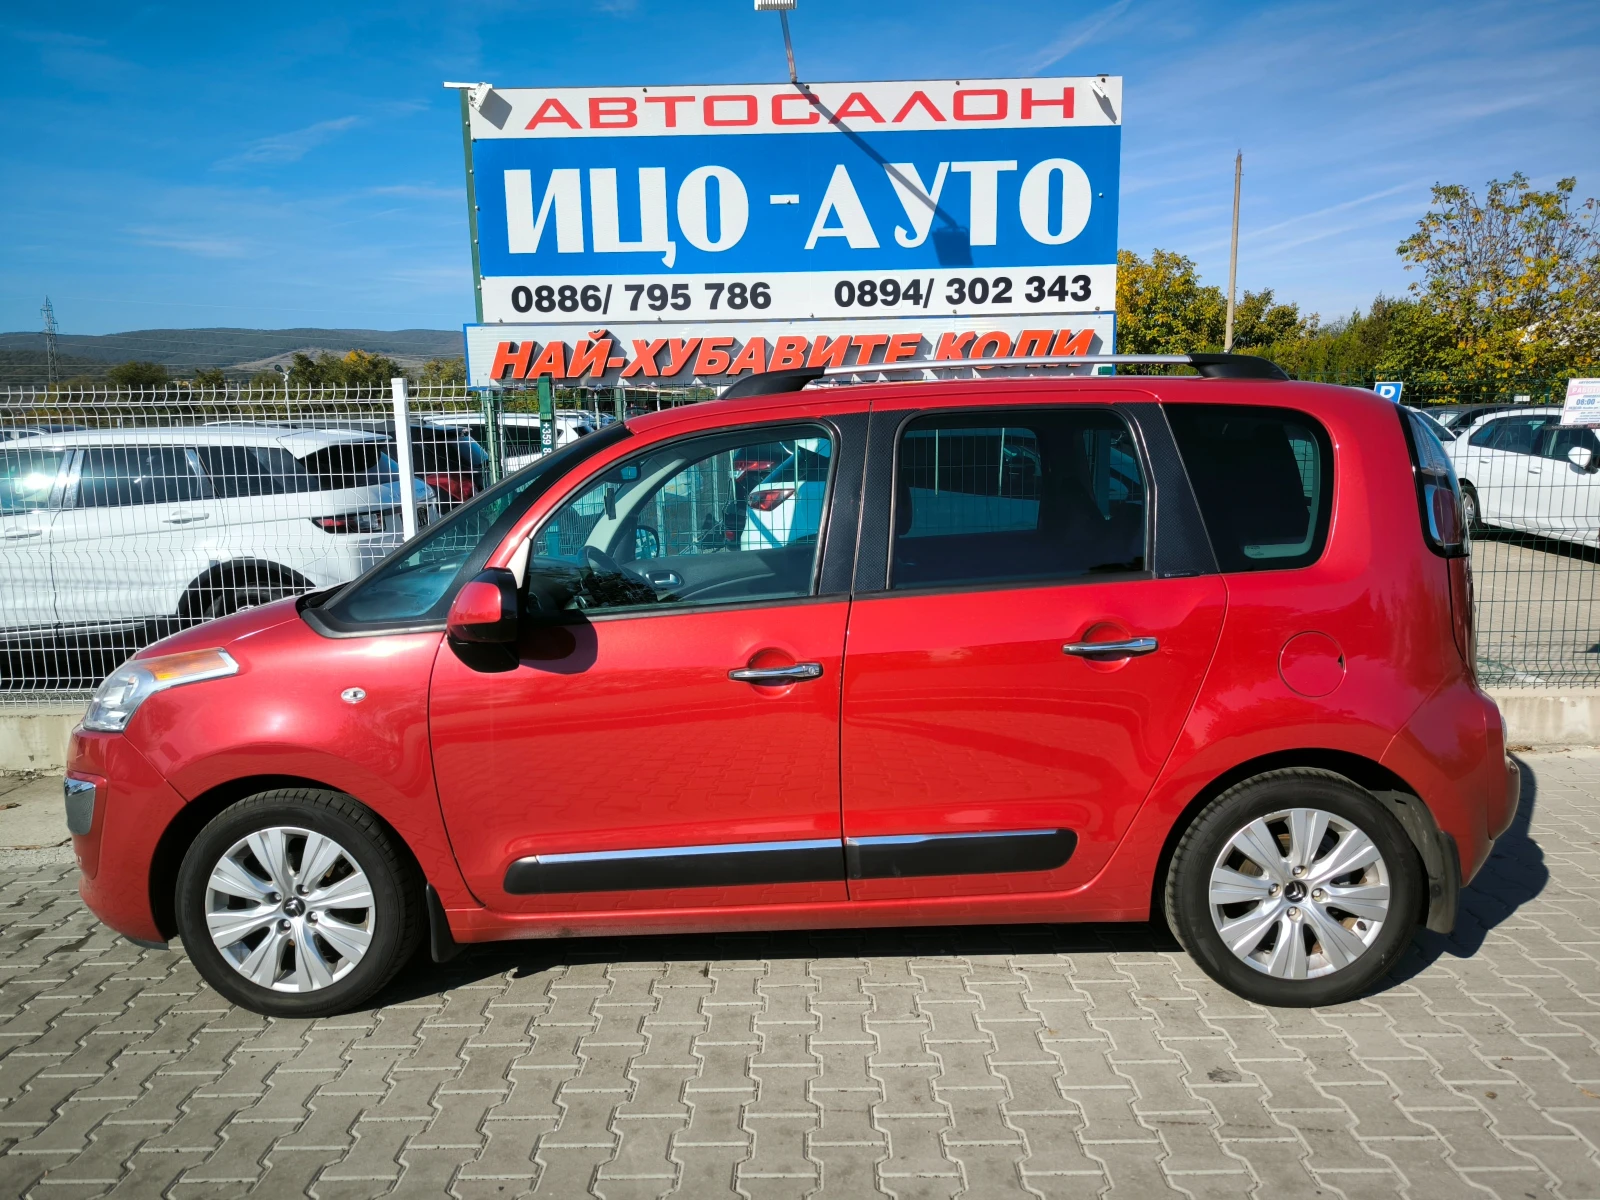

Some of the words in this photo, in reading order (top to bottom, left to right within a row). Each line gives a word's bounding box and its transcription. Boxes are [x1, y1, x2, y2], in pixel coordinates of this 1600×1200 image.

[524, 87, 1075, 129] АВТОСАЛОН
[504, 165, 749, 267] ИЦО
[804, 158, 1092, 250] АУТО
[511, 285, 613, 314] 0886/
[624, 283, 691, 311] 795
[704, 281, 772, 309] 786
[834, 278, 934, 309] 0894/
[946, 277, 1012, 304] 302
[1025, 275, 1092, 303] 343
[490, 330, 922, 378] НАЙ-ХУБАВИТЕ
[1380, 386, 1396, 399] P
[1576, 398, 1596, 406] 08:00
